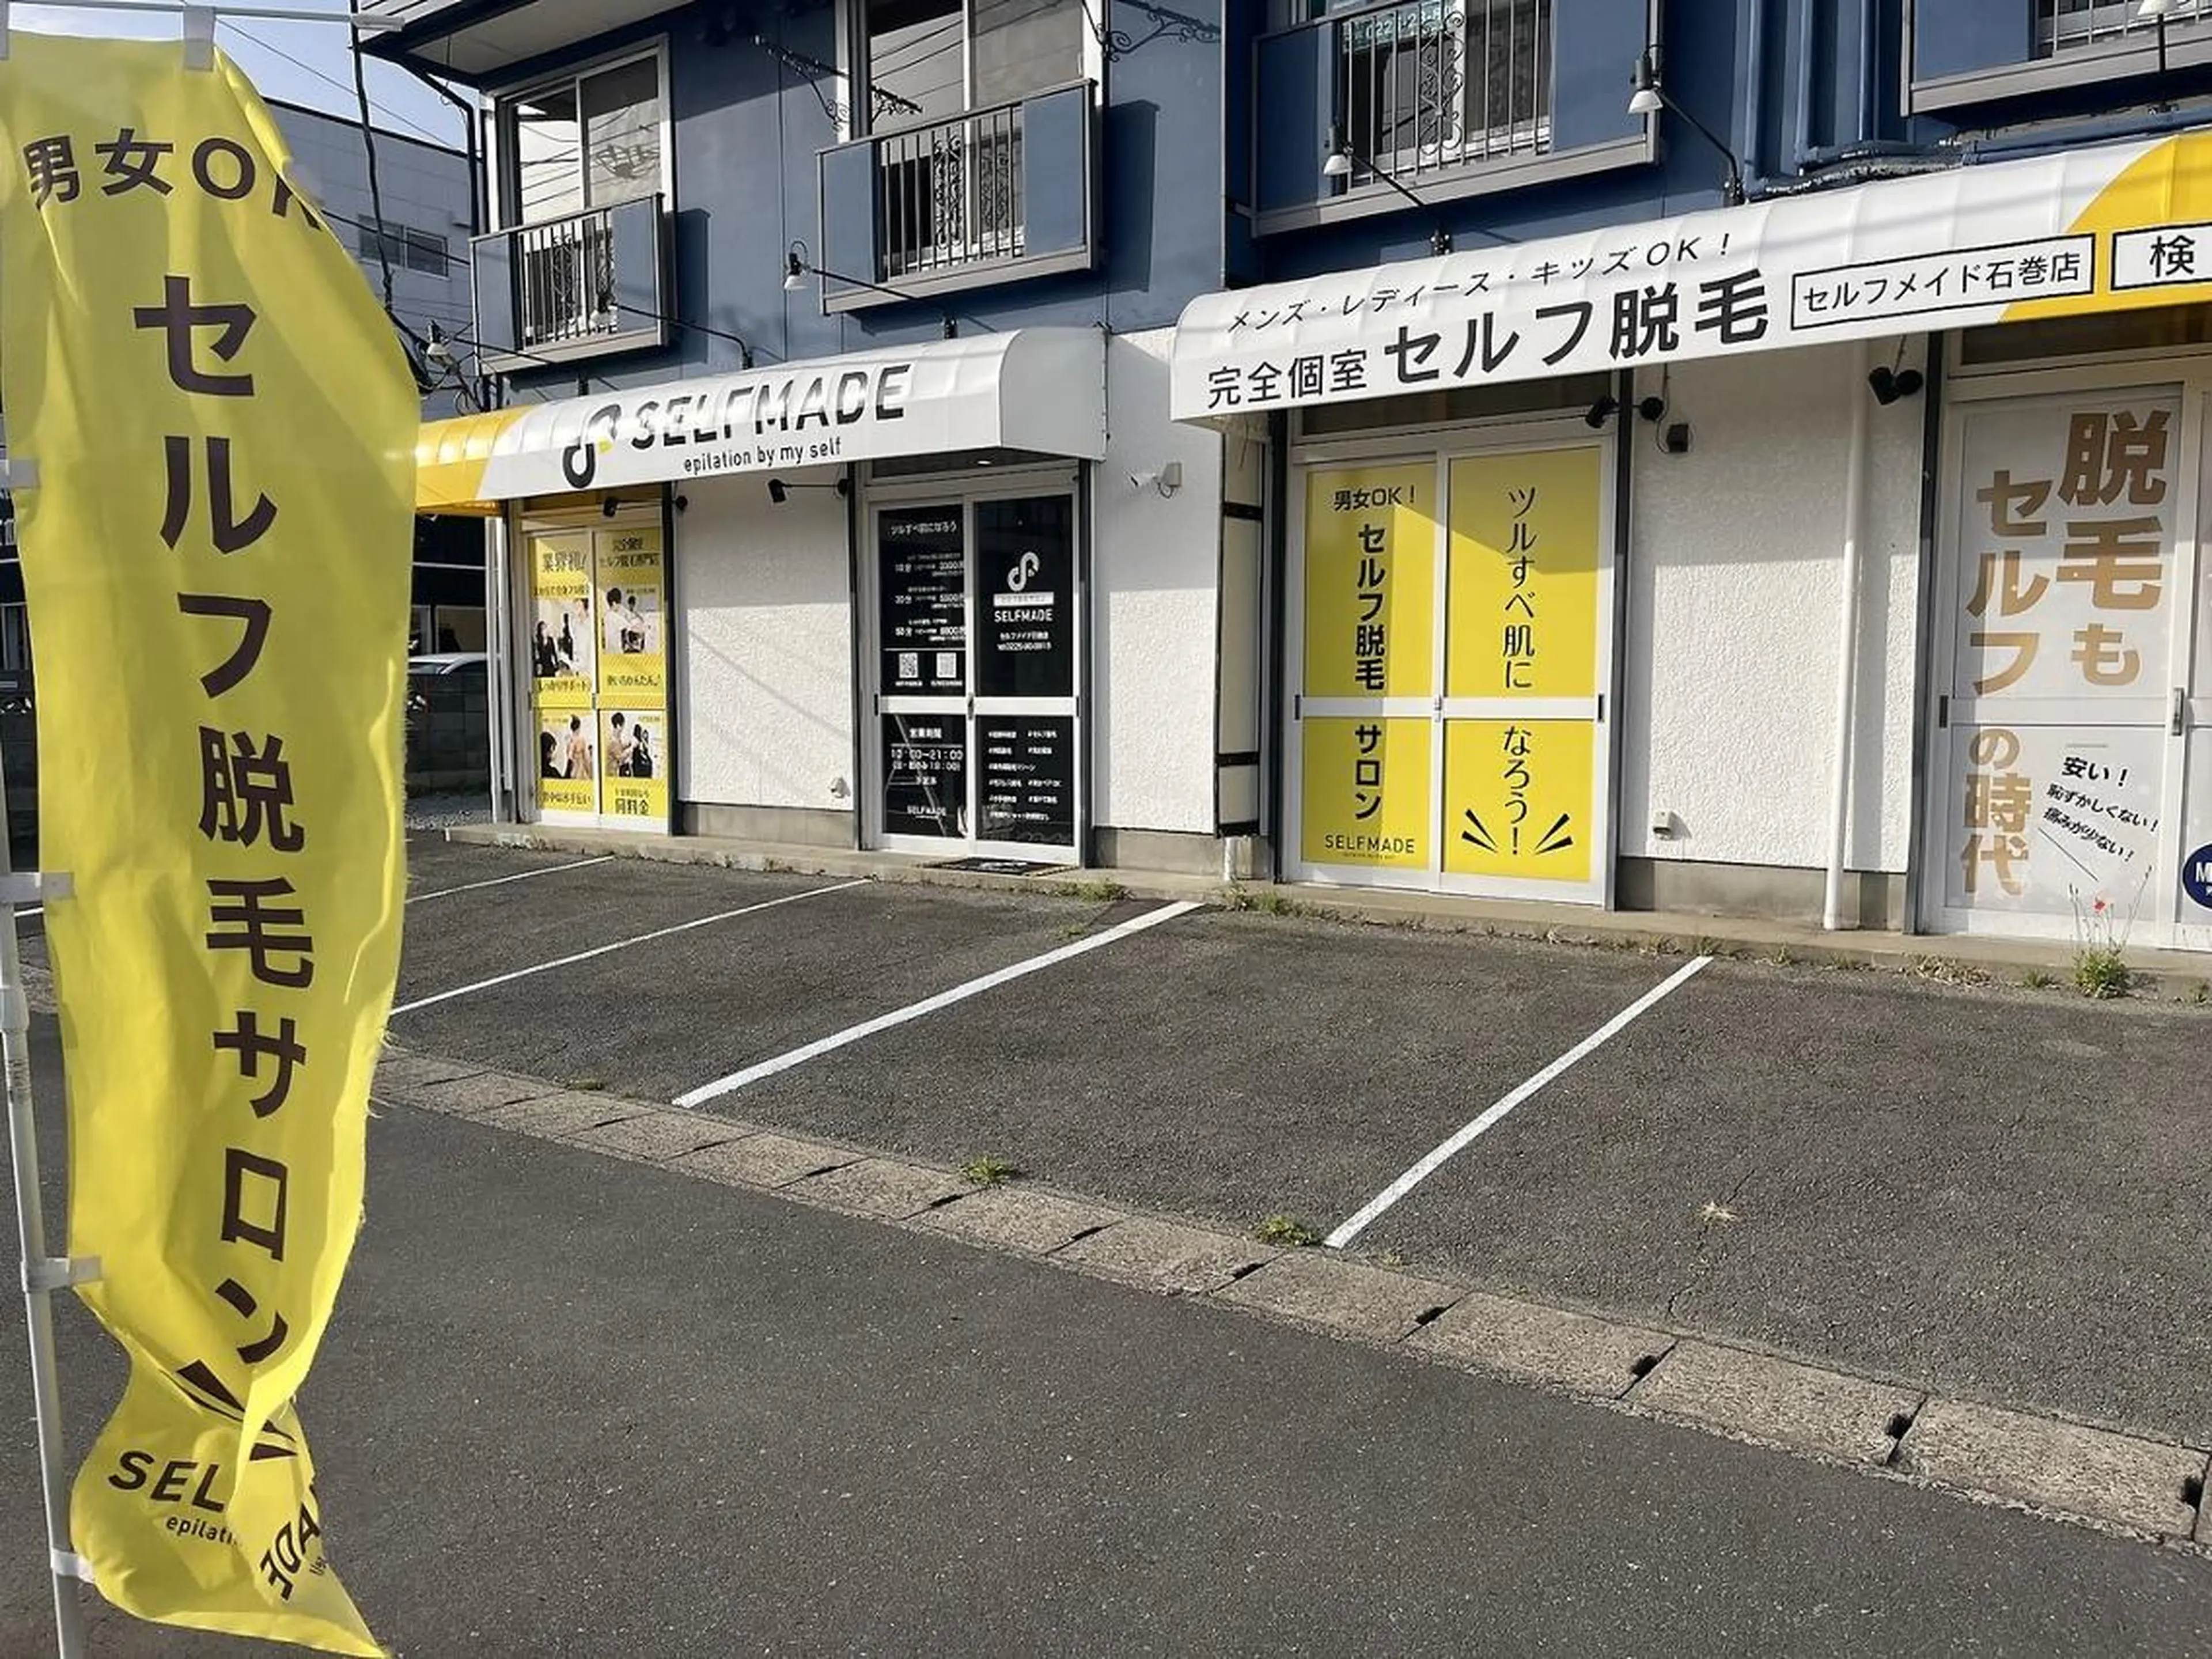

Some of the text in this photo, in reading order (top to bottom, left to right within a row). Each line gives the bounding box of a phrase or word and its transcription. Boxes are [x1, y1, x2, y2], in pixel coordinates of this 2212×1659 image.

[2149, 234, 2195, 278] 検
[1803, 252, 2081, 313] セルフメイド石巻店
[1208, 268, 1768, 409] 完全個室 セルフ脱毛
[631, 363, 911, 450] SELFMADE
[684, 437, 841, 473] epilation by my self
[2056, 410, 2171, 686] 脱毛も
[994, 608, 1053, 623] SELFMADE
[134, 275, 315, 1364] セルフ脱毛サロン
[1325, 834, 1415, 855] SELFMADE
[166, 1516, 238, 1546] epilati
